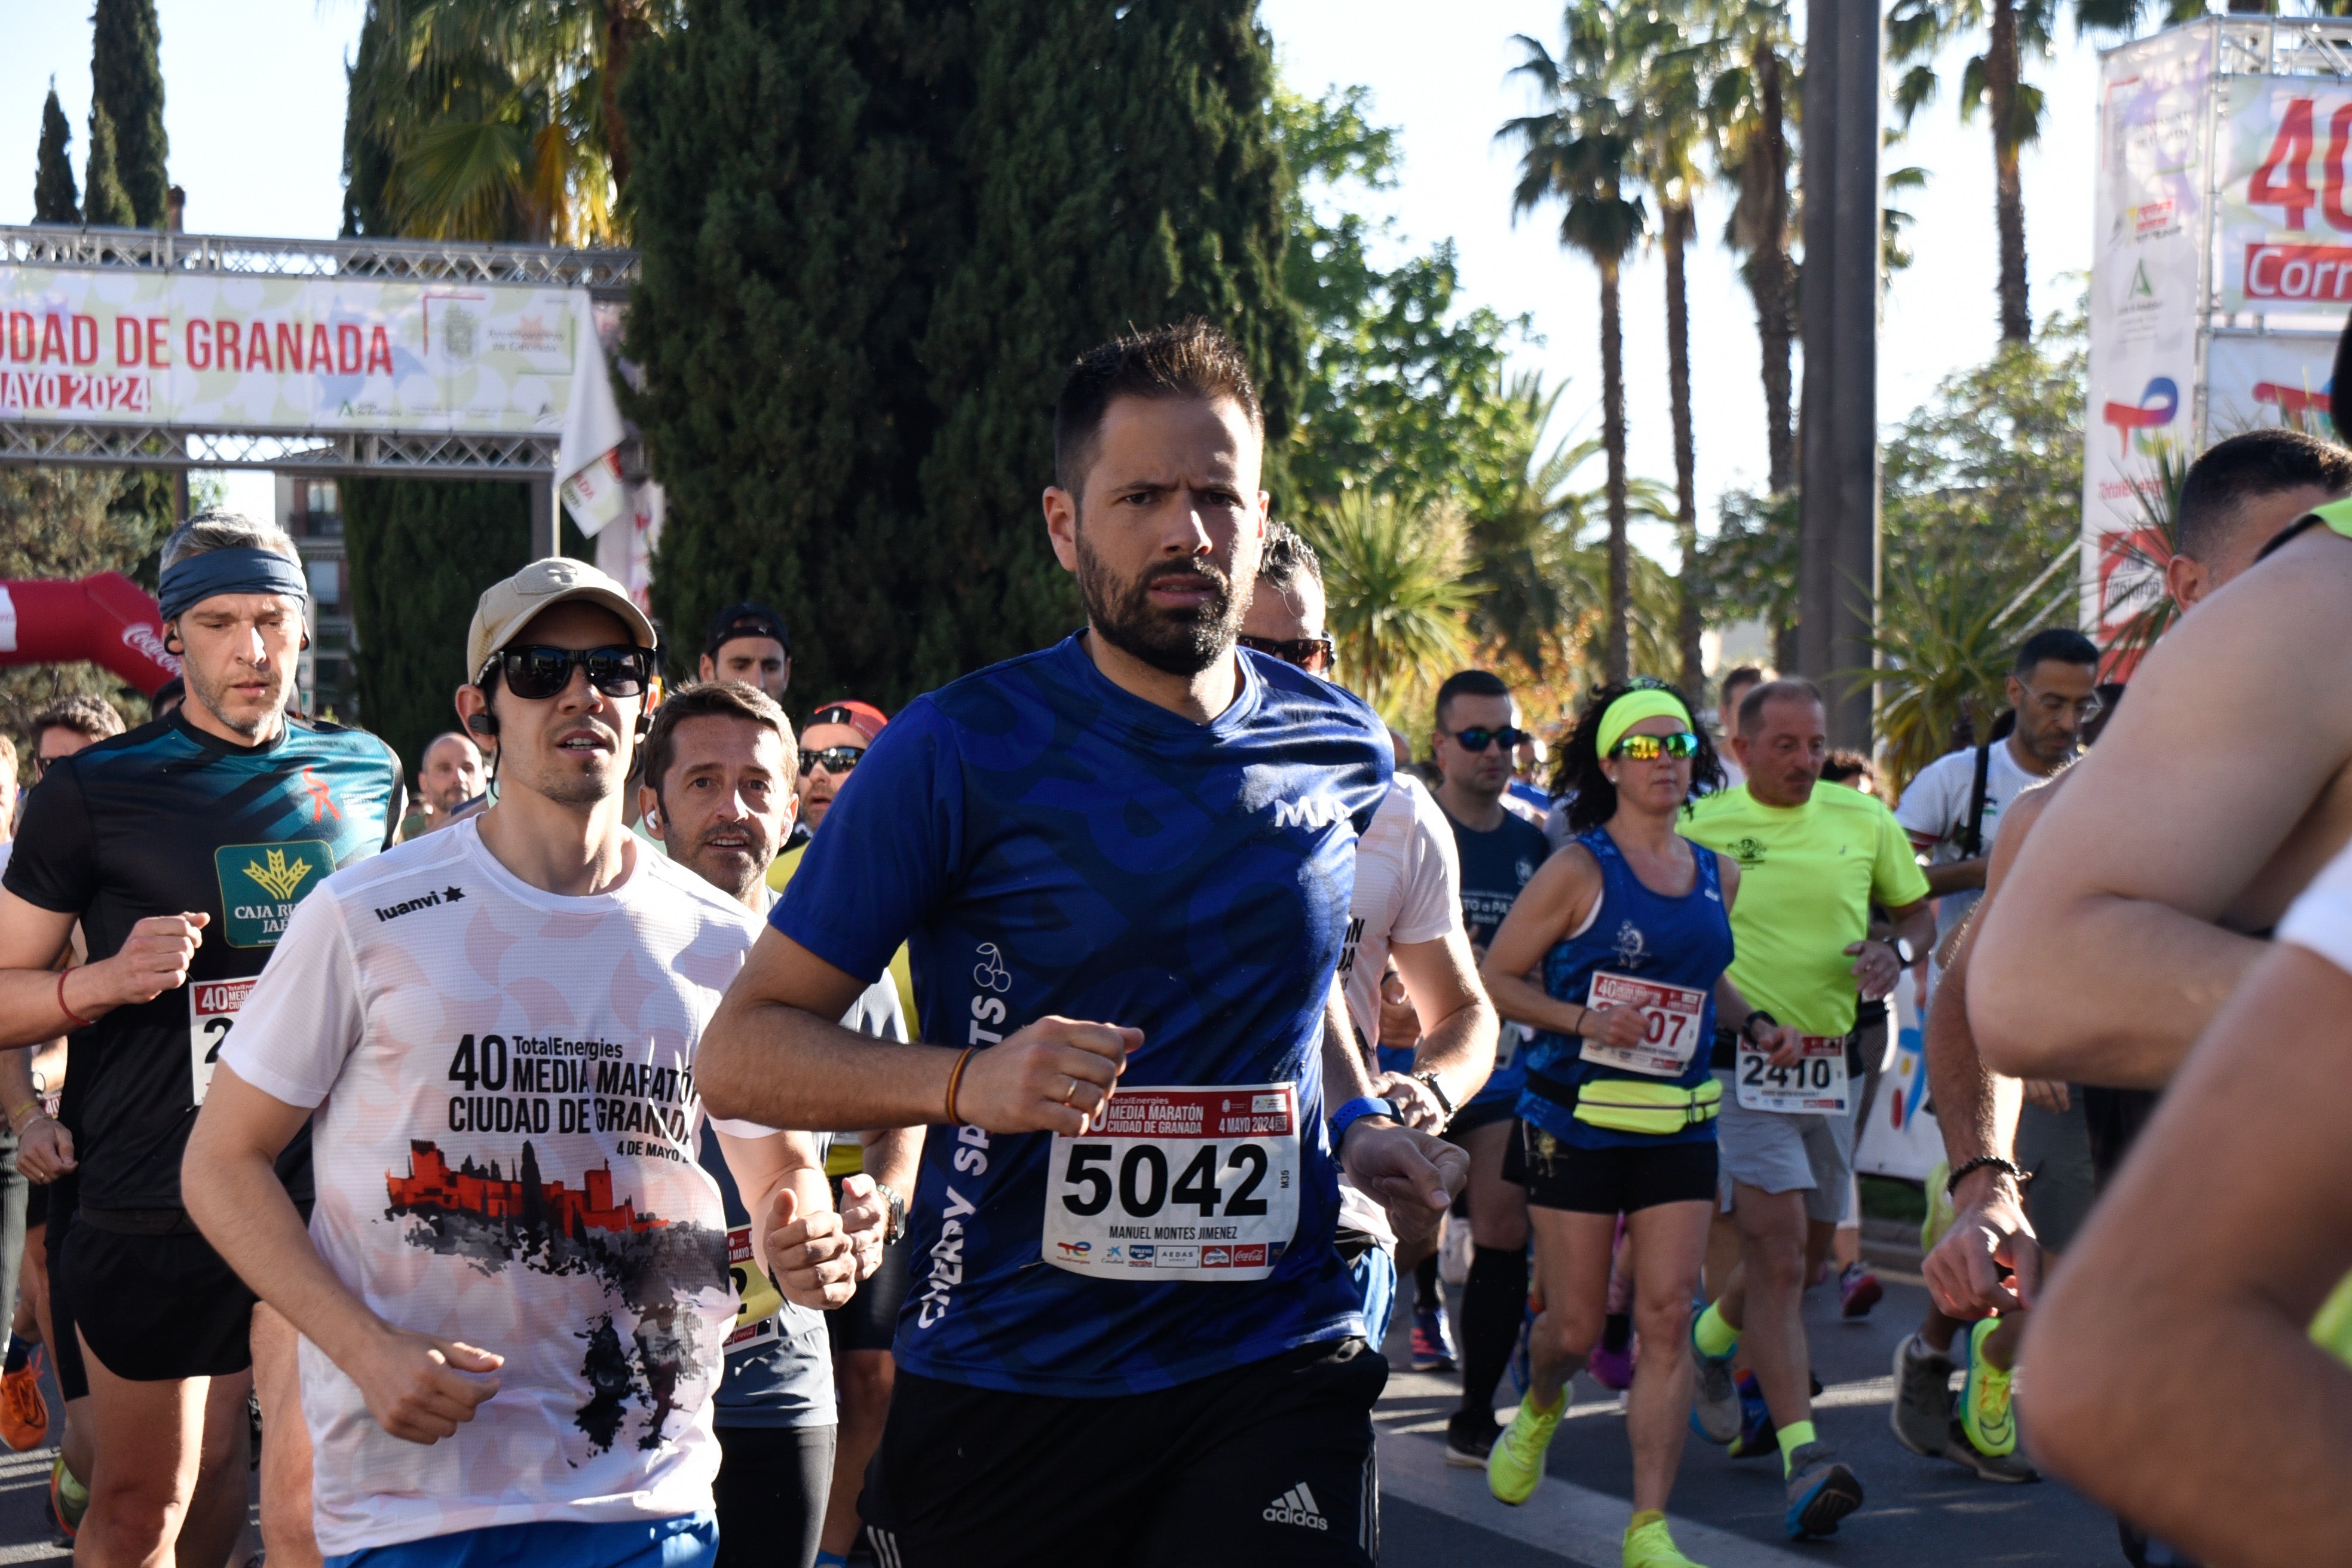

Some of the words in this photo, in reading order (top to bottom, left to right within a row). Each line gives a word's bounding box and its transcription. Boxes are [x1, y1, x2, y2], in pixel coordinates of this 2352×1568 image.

[0, 311, 99, 365] DAD
[115, 317, 170, 369] DE
[186, 319, 393, 376] GRANADA
[70, 375, 150, 412] 2024
[234, 905, 274, 919] CAJA
[375, 891, 441, 922] luanvi
[201, 987, 228, 1011] 40
[1598, 979, 1616, 997] 40
[449, 1034, 507, 1091] 40
[513, 1036, 623, 1061] TotalEnergies
[1742, 1055, 1830, 1089] 2410
[513, 1058, 590, 1093] MEDIA
[596, 1061, 697, 1107] MARATÓ
[1109, 1105, 1145, 1120] MEDIA
[1149, 1103, 1203, 1121] MARATÓN
[1111, 1097, 1169, 1105] TotalEnergies
[449, 1097, 549, 1134] CIUDAD
[559, 1099, 591, 1134] DE
[1219, 1119, 1225, 1133] 4
[1227, 1117, 1251, 1133] MAYO
[1252, 1116, 1275, 1132] 2024
[1107, 1120, 1142, 1132] CIUDAD
[1144, 1121, 1156, 1133] DE
[1159, 1122, 1202, 1134] GRANADA
[617, 1141, 624, 1156] 4
[627, 1141, 642, 1156] DE
[645, 1143, 679, 1162] MAYO
[1062, 1144, 1268, 1218] 5042
[1281, 1169, 1290, 1189] M35
[1109, 1226, 1152, 1239] MANUEL
[1154, 1227, 1195, 1240] MONTES
[1198, 1226, 1238, 1240] JIMENEZ
[733, 1247, 749, 1260] MAYO
[1262, 1507, 1328, 1531] adidas
